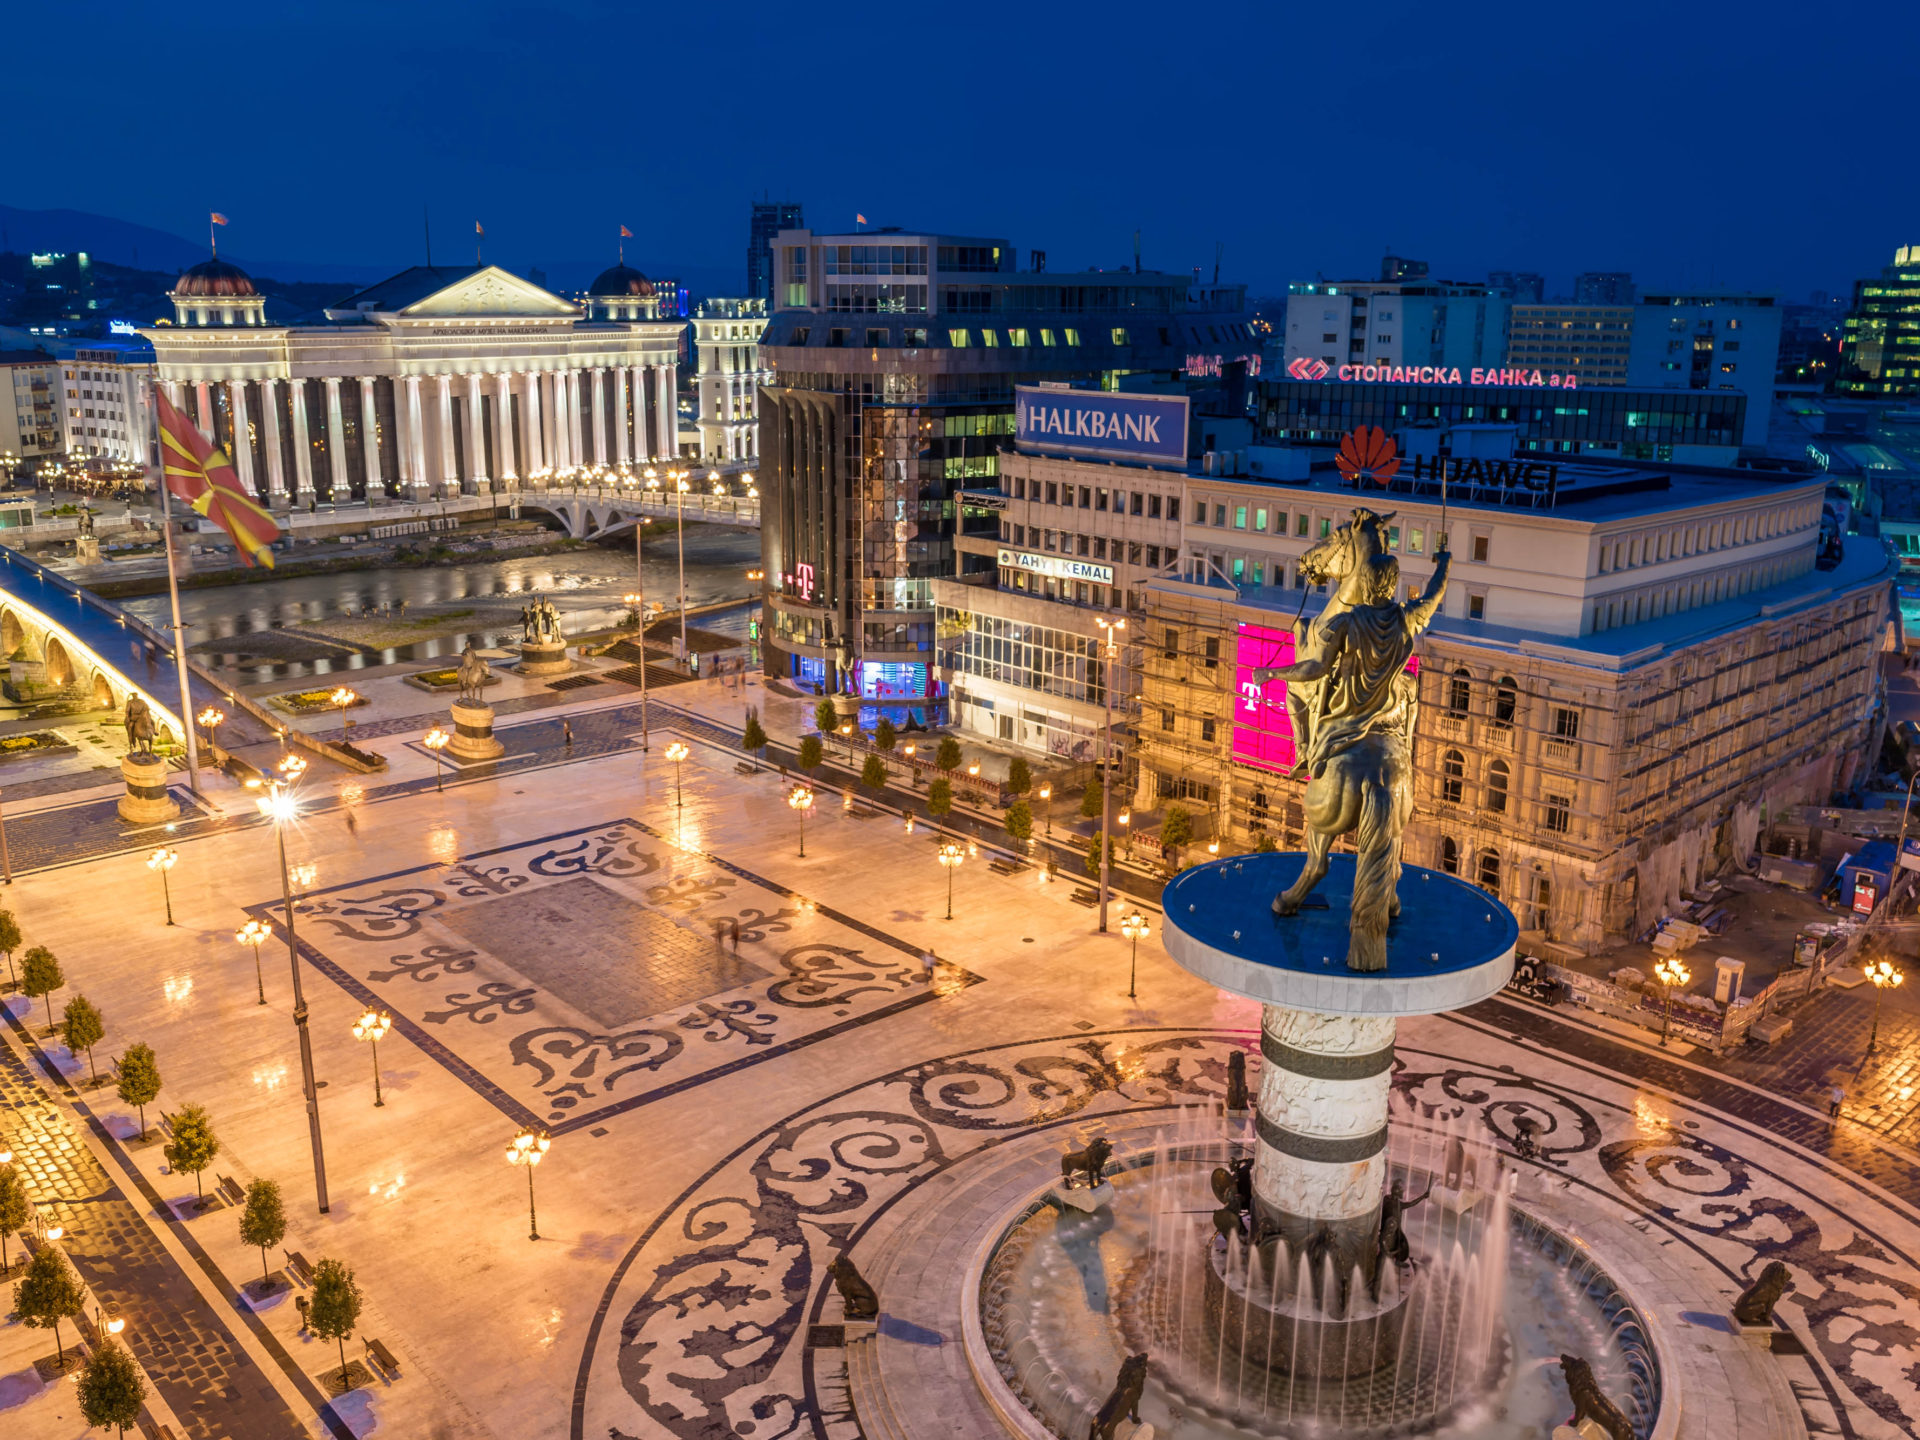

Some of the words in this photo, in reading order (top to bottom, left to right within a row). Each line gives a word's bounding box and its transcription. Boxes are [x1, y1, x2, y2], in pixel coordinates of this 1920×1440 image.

[1338, 365, 1462, 385] СТОПАНСКА
[1470, 368, 1543, 387] БАНКА
[1029, 406, 1161, 444] HALKBANK
[1414, 453, 1557, 493] HUAWEI
[1013, 553, 1057, 570] YAHY
[1061, 561, 1111, 581] KEMAL
